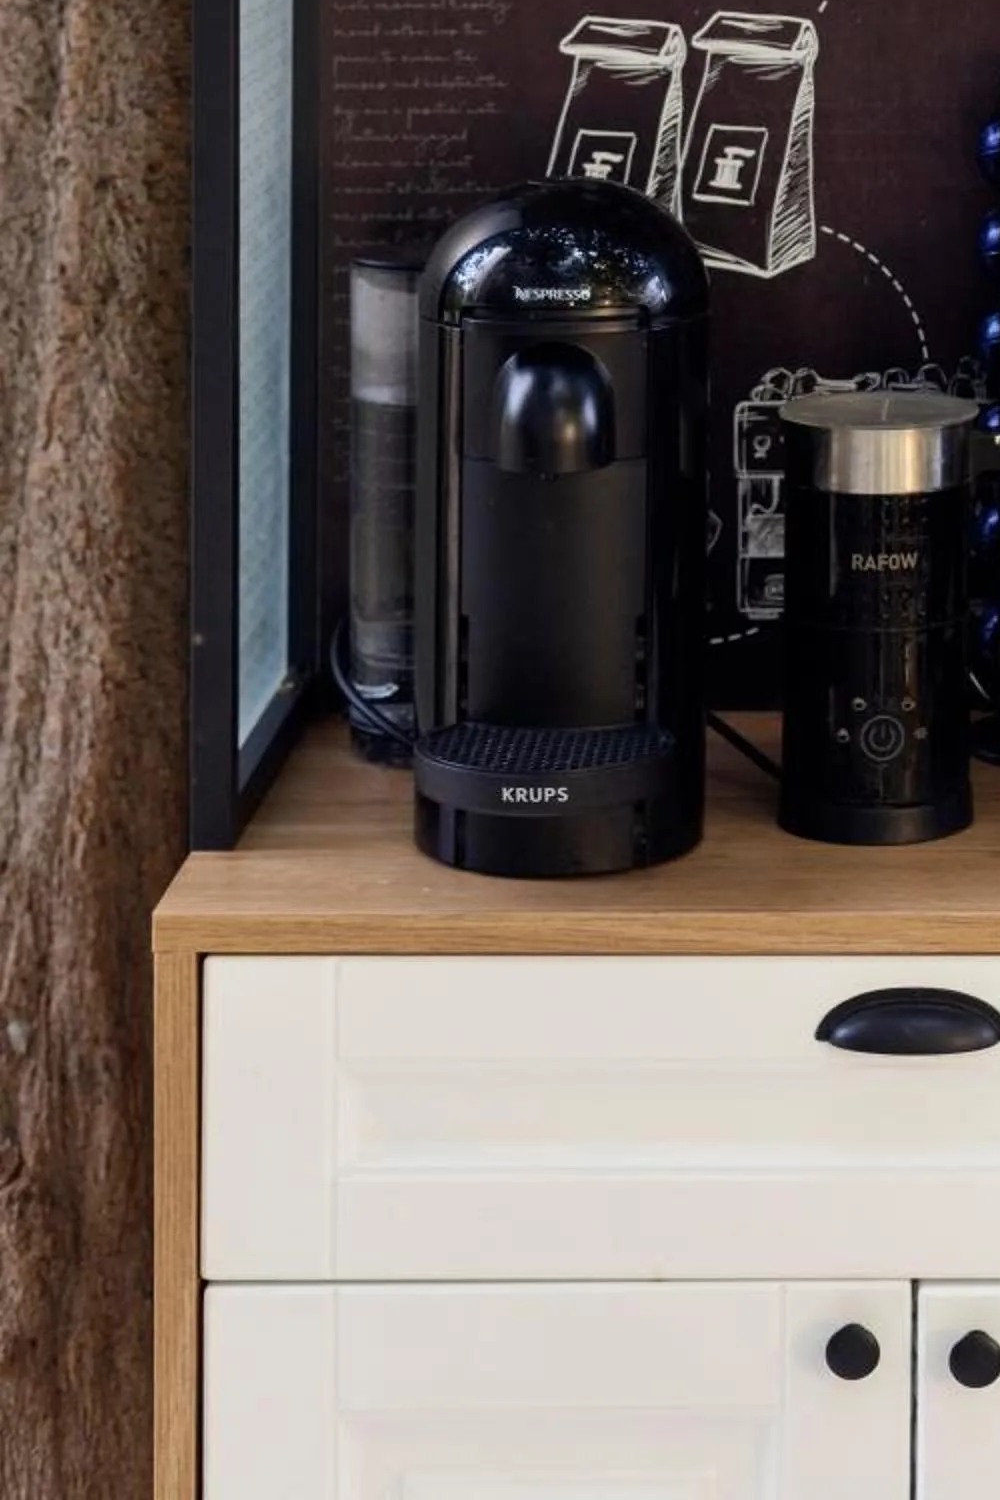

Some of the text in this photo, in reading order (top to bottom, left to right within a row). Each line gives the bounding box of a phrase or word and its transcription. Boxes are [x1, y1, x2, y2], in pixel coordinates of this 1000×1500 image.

[512, 284, 593, 302] NESPRESSO
[852, 553, 919, 572] RAFOW
[501, 787, 569, 803] KRUPS
